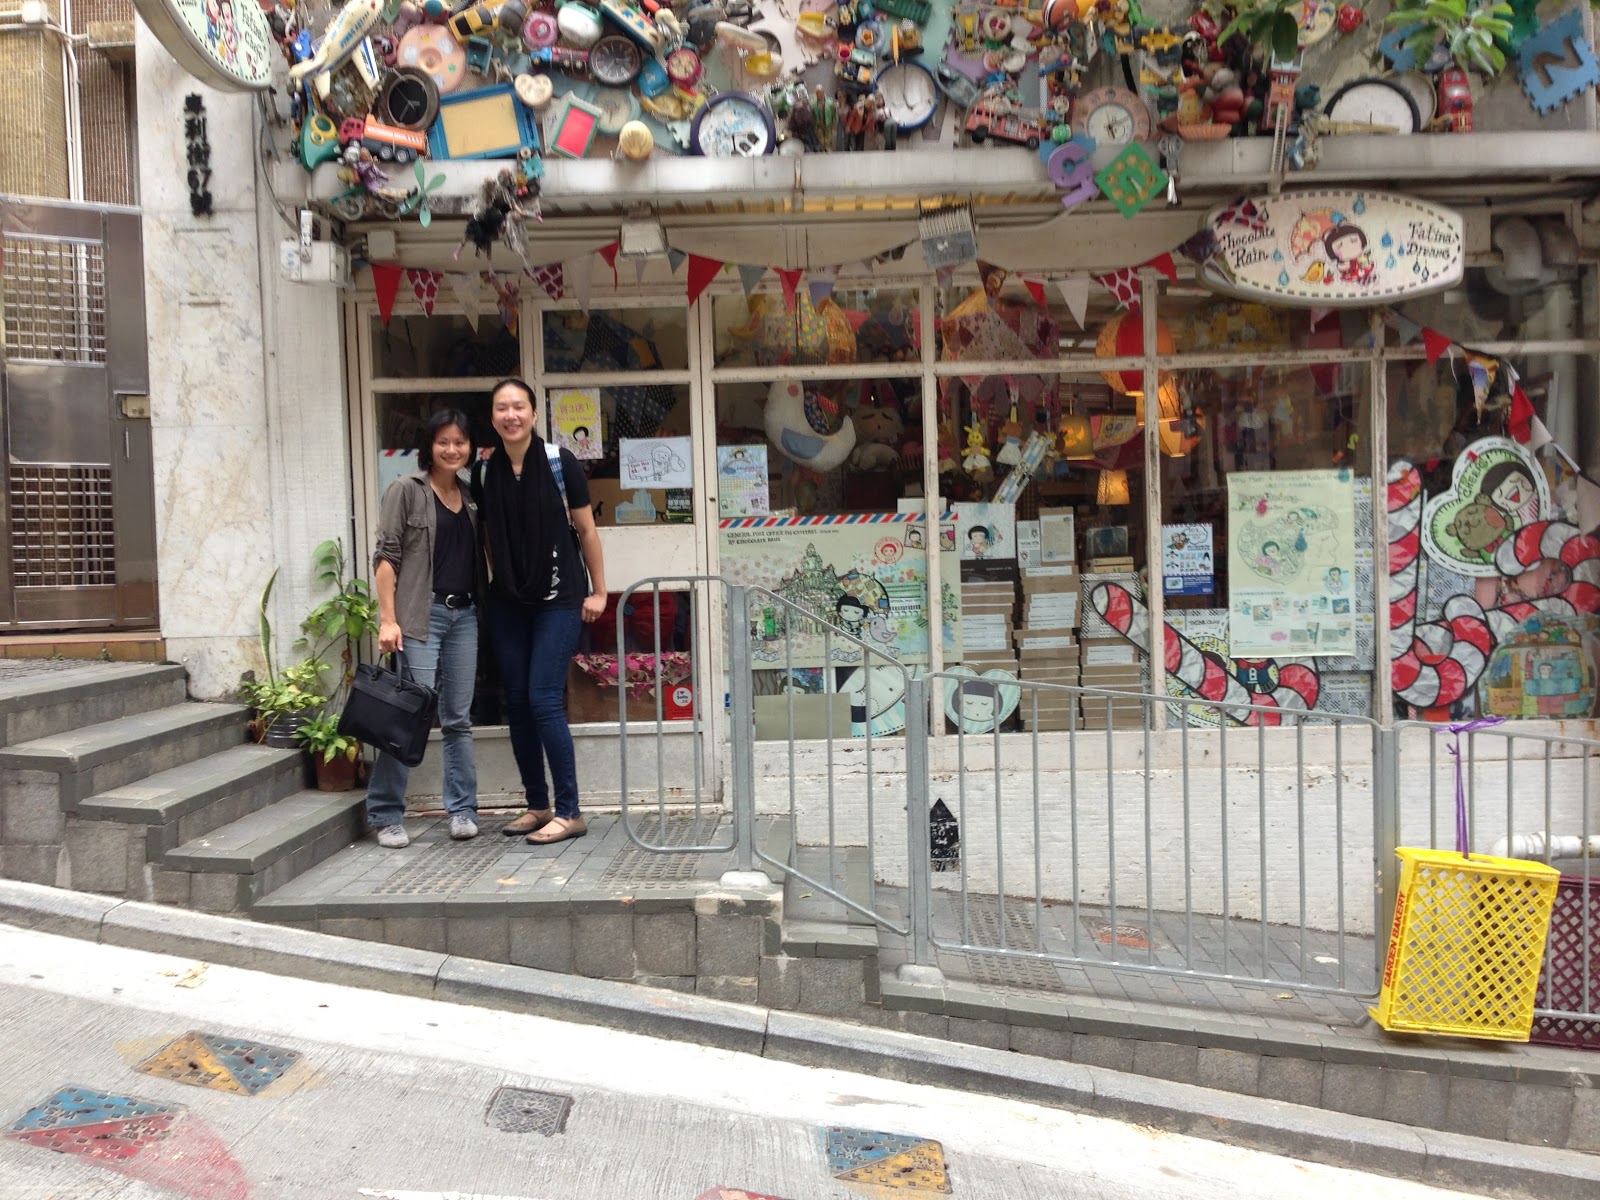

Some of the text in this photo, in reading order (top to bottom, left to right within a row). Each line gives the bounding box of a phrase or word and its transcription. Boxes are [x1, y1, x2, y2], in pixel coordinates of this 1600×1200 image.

[1234, 247, 1269, 268] Rain
[1384, 890, 1406, 988] GARDEN BAKERY
